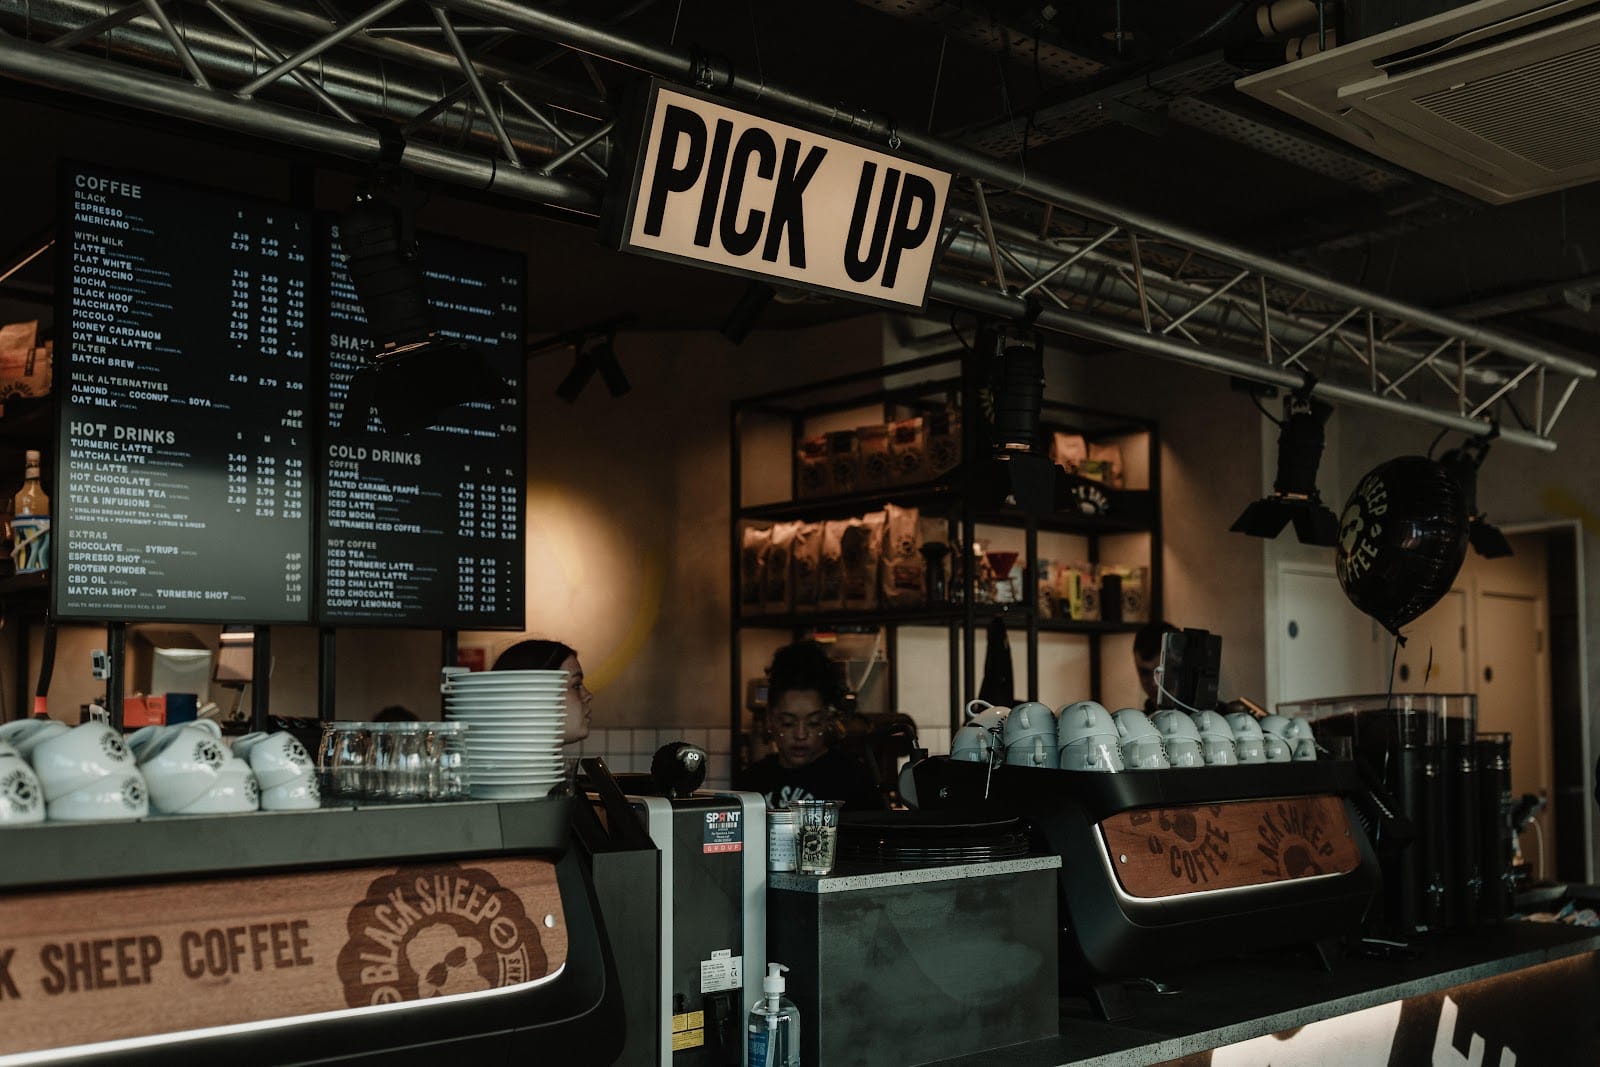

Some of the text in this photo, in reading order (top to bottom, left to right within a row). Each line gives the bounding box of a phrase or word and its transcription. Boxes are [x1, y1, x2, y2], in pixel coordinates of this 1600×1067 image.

[75, 175, 141, 199] COFFEE
[75, 191, 106, 203] BLACK
[643, 104, 936, 288] PICK UP
[75, 202, 123, 217] ESPRESSO
[75, 213, 129, 229] AMERICANO
[74, 231, 123, 247] WITH MILK
[74, 242, 106, 255] LATTE
[74, 254, 99, 264] FLAT
[102, 258, 132, 270] WHITE
[74, 265, 133, 281] CAPPUCCINO
[74, 276, 106, 288] MOCHA
[73, 287, 104, 299] BLACK
[108, 293, 133, 303] HOOF
[73, 298, 128, 313] MACCHIATO
[73, 309, 114, 322] PICCOLO
[73, 321, 105, 332] HONEY
[109, 326, 161, 340] CARDAMOM
[73, 332, 93, 341] OAT
[96, 335, 118, 345] MILK
[121, 338, 152, 350] LATTE
[72, 343, 106, 354] FILTER
[72, 354, 134, 368] BATCH BREW
[330, 352, 357, 362] CACAO
[72, 373, 168, 391] MILK ALTERNATIVES
[71, 395, 92, 404] OAT
[95, 397, 117, 407] MILK
[72, 384, 108, 395] ALMOND
[129, 391, 169, 402] COCONUT
[189, 397, 211, 407] SOYA
[281, 418, 303, 429] FREE
[70, 422, 175, 444] HOT DRINKS
[70, 438, 153, 453] TURMERIC LATTE
[70, 450, 110, 461] MATCHA
[114, 454, 145, 464] LATTE
[329, 445, 421, 465] COLD DRINKS
[70, 461, 93, 471] CHAI
[96, 463, 128, 474] LATTE
[329, 460, 359, 470] COFFEE
[70, 472, 150, 486] HOT CHOCOLATE
[329, 479, 357, 489] SALTED
[358, 482, 391, 492] CARAMEL
[70, 484, 110, 494] MATCHA
[113, 487, 144, 496] GREEN
[147, 489, 166, 498] TEA
[328, 490, 393, 502] ICED AMERICANO
[70, 495, 89, 503] TEA
[102, 497, 150, 508] INFUSIONS
[328, 500, 374, 510] ICED LATTE
[328, 509, 376, 520] ICED MOCHA
[329, 519, 374, 529] VIETNAMESE
[375, 523, 392, 531] ICED
[394, 524, 420, 533] COFFEE
[69, 530, 108, 540] EXTRAS
[69, 541, 123, 552] CHOCOLATE
[146, 545, 178, 554] SYRUPS
[328, 539, 376, 549] NOT COFFEE
[69, 552, 114, 562] ESPRESSO
[117, 554, 140, 563] SHOT
[328, 549, 364, 558] ICED TEA
[68, 563, 107, 573] PROTEIN
[109, 565, 146, 575] POWDER
[328, 559, 346, 567] ICED
[348, 560, 386, 569] TURMERIC
[389, 563, 414, 571] LATTE
[68, 575, 88, 583] CBD
[91, 576, 106, 584] OIL
[327, 569, 407, 580] ICED MATCHA LATTE
[327, 579, 346, 587] ICED
[368, 581, 394, 589] LATTE
[68, 586, 108, 595] MATCHA
[112, 588, 137, 596] SHOT
[156, 589, 202, 599] TURMERIC
[205, 591, 229, 599] SHOT
[327, 589, 394, 599] ICED CHOCOLATE
[327, 599, 401, 608] CLOUDY LEMONADE
[1170, 817, 1229, 884] COFFEE
[360, 874, 503, 985] BLACK SHEEP
[39, 935, 163, 995] SHEEP
[180, 918, 315, 980] COFFEE
